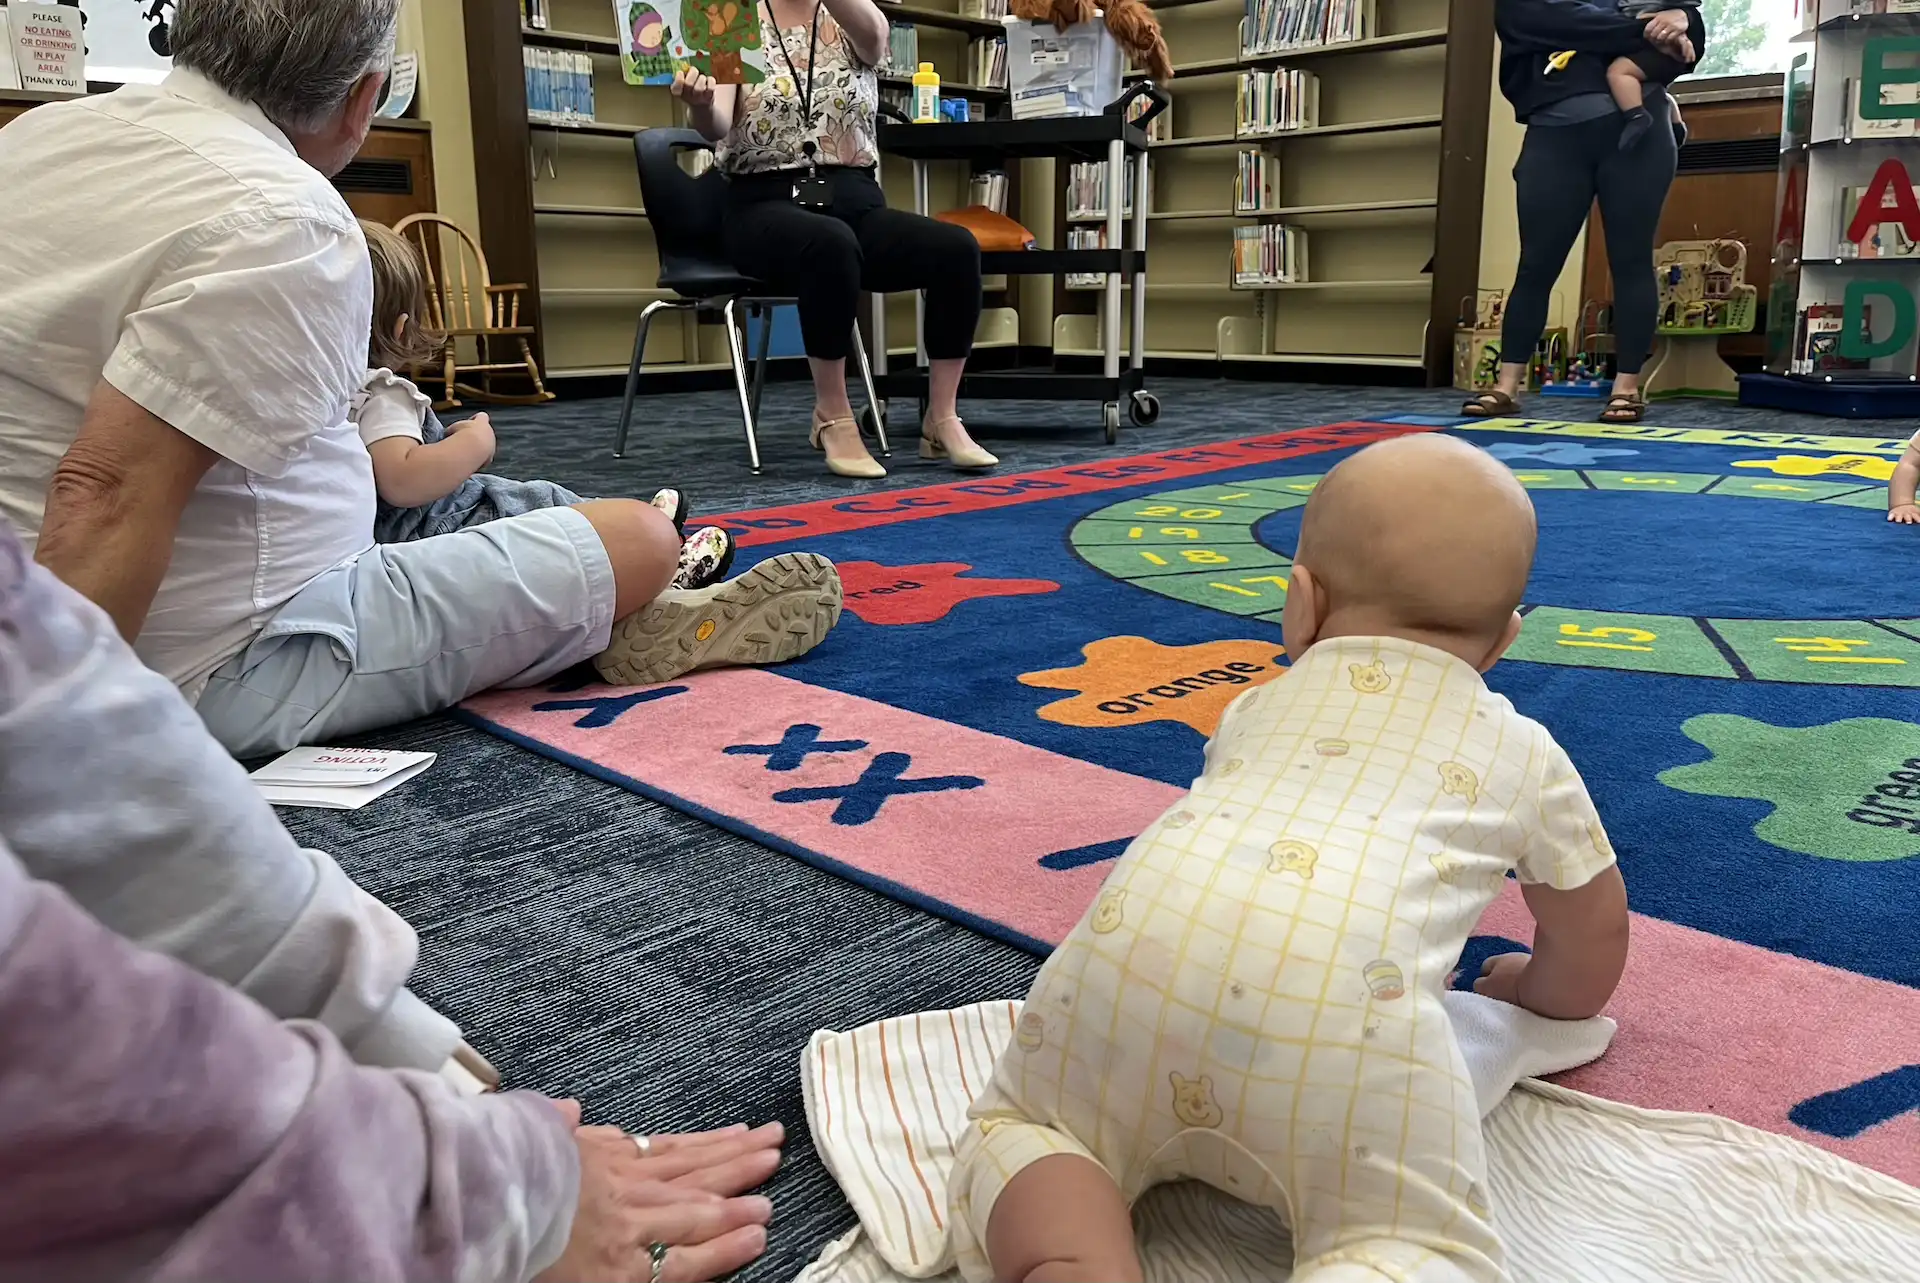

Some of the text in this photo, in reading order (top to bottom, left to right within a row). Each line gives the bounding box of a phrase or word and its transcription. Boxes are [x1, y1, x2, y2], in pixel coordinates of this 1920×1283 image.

[32, 13, 62, 23] PLEASE
[25, 26, 71, 37] NO EATING
[20, 37, 76, 51] OR DRINKING
[34, 51, 66, 61] IN PLAY
[38, 64, 63, 73] AREA!
[25, 76, 77, 87] THANK YOU!
[1840, 280, 1916, 359] D
[1134, 506, 1224, 519] 20
[1128, 527, 1200, 539] 19
[1138, 549, 1231, 566] 18
[846, 580, 926, 600] red
[1555, 623, 1658, 652] 15
[1773, 637, 1908, 665] 14
[1096, 662, 1265, 714] orange
[313, 755, 388, 765] VOTING
